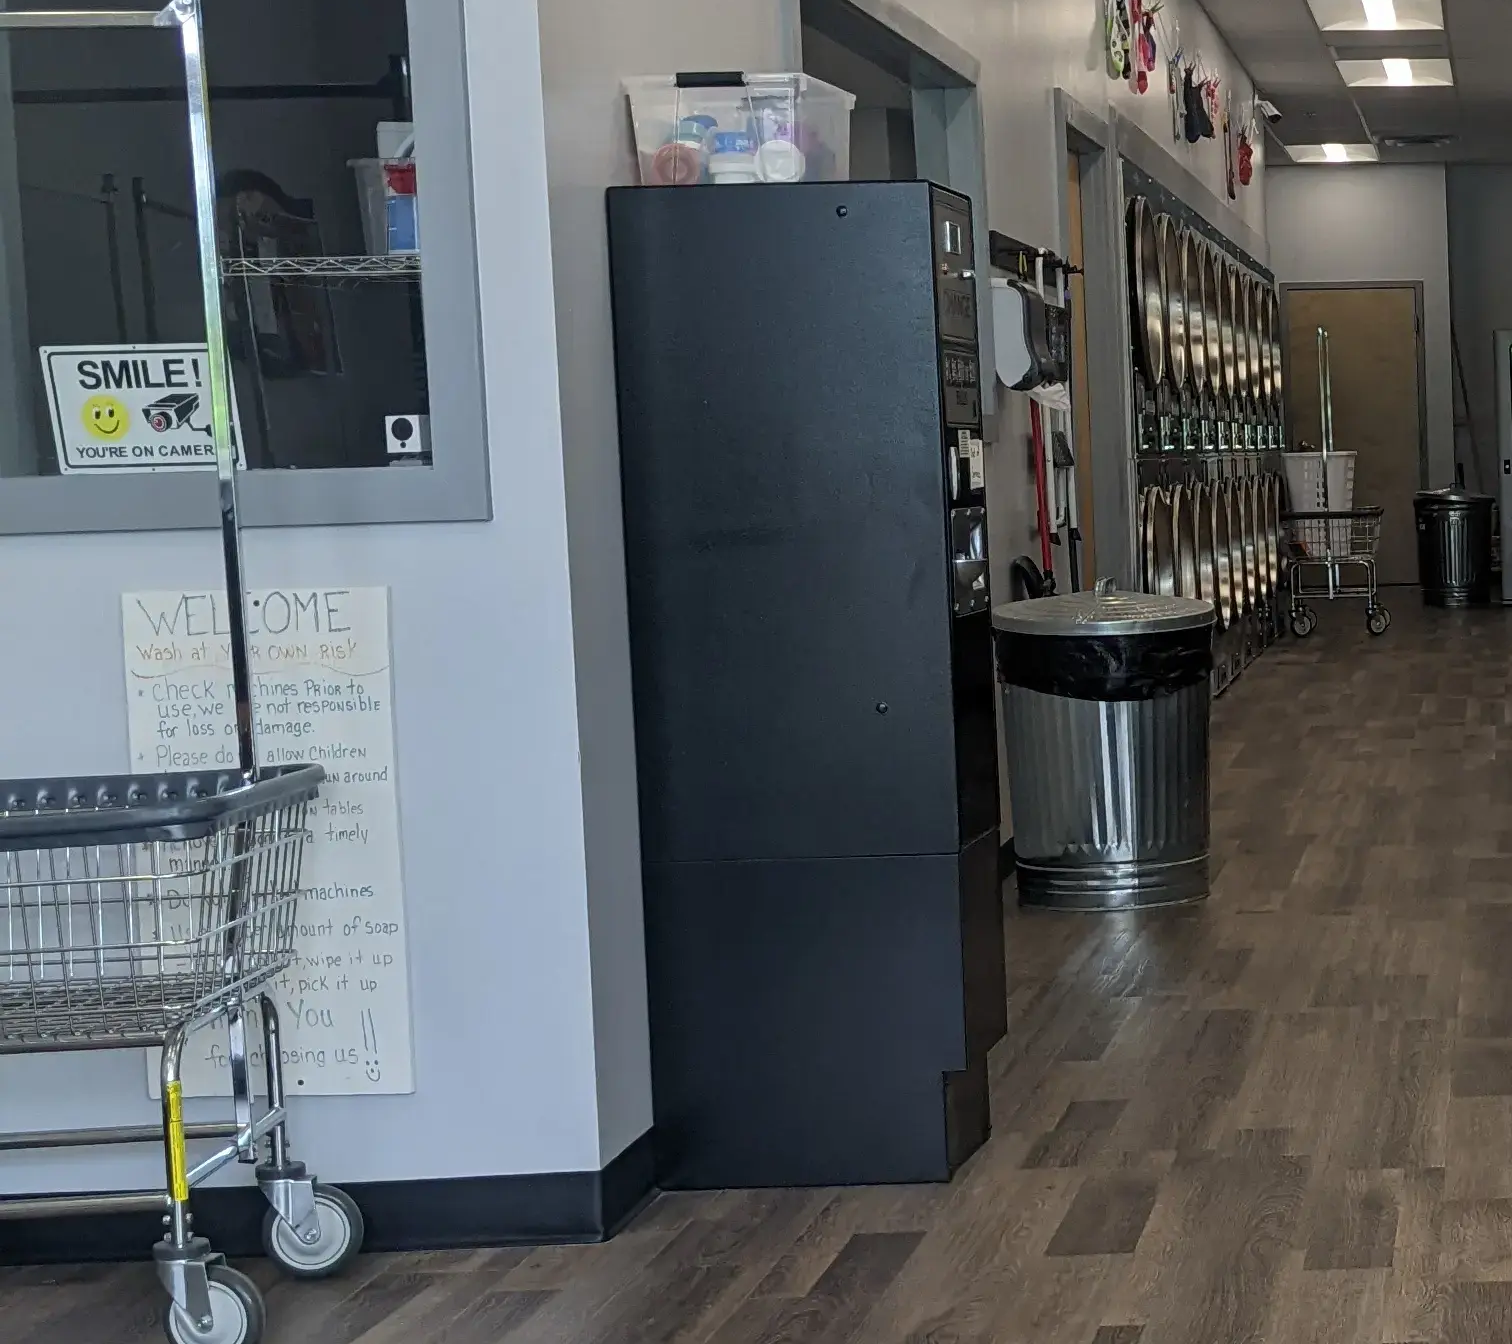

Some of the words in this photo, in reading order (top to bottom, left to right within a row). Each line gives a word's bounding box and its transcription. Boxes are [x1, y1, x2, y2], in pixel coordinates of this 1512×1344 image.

[76, 446, 128, 459] YOU'RE
[131, 445, 154, 458] ON
[158, 443, 216, 457] CAMER
[191, 641, 209, 661] at
[346, 678, 364, 696] to
[266, 697, 292, 714] not
[157, 720, 178, 739] for
[187, 718, 215, 736] loss
[156, 744, 209, 767] Please
[215, 744, 234, 764] do
[343, 765, 388, 784] around
[322, 798, 364, 815] tables
[324, 821, 368, 844] timely
[304, 882, 374, 901] machines
[343, 915, 362, 937] of
[365, 920, 399, 940] soap
[306, 954, 342, 968] wipe
[350, 951, 363, 965] it
[372, 954, 394, 966] up
[335, 973, 349, 990] it
[360, 979, 378, 993] up
[286, 998, 335, 1030] You
[334, 1047, 359, 1065] us
